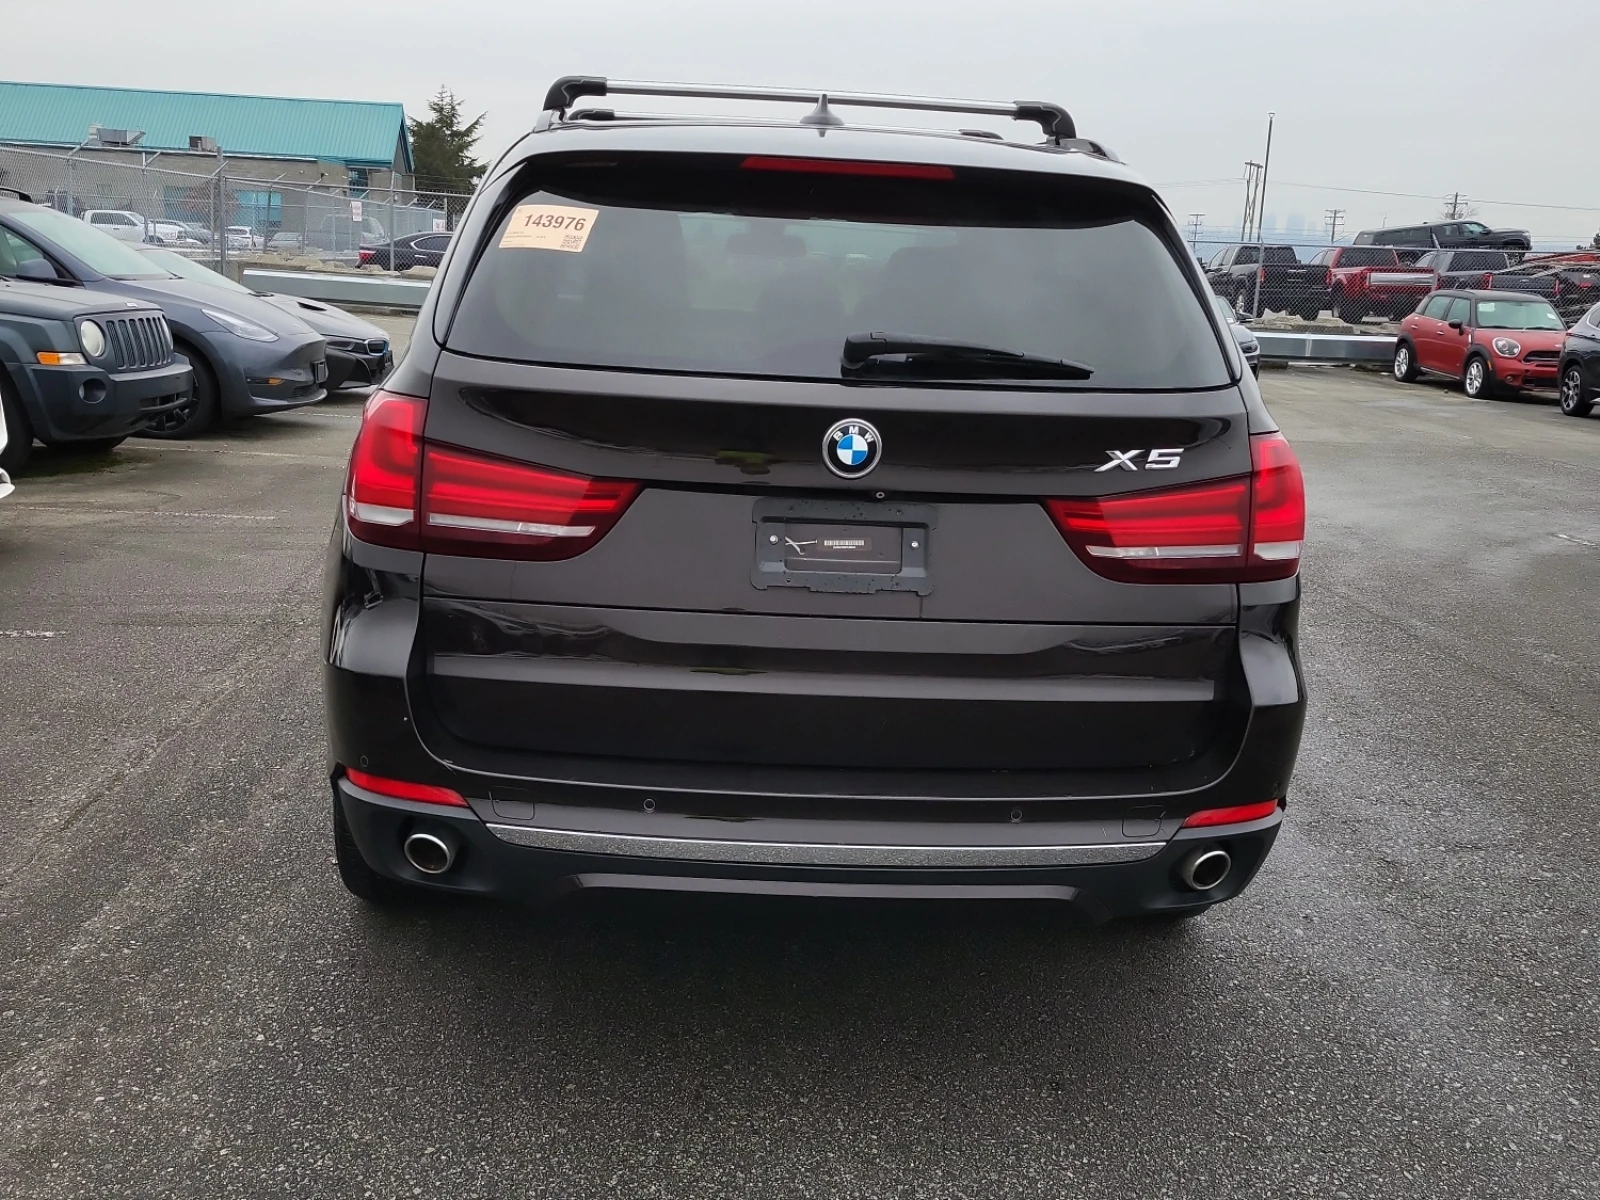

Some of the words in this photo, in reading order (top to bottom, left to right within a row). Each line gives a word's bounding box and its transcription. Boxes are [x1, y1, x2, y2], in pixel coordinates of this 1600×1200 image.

[524, 213, 587, 231] 143976
[832, 425, 875, 443] BMW
[1093, 448, 1185, 472] X5
